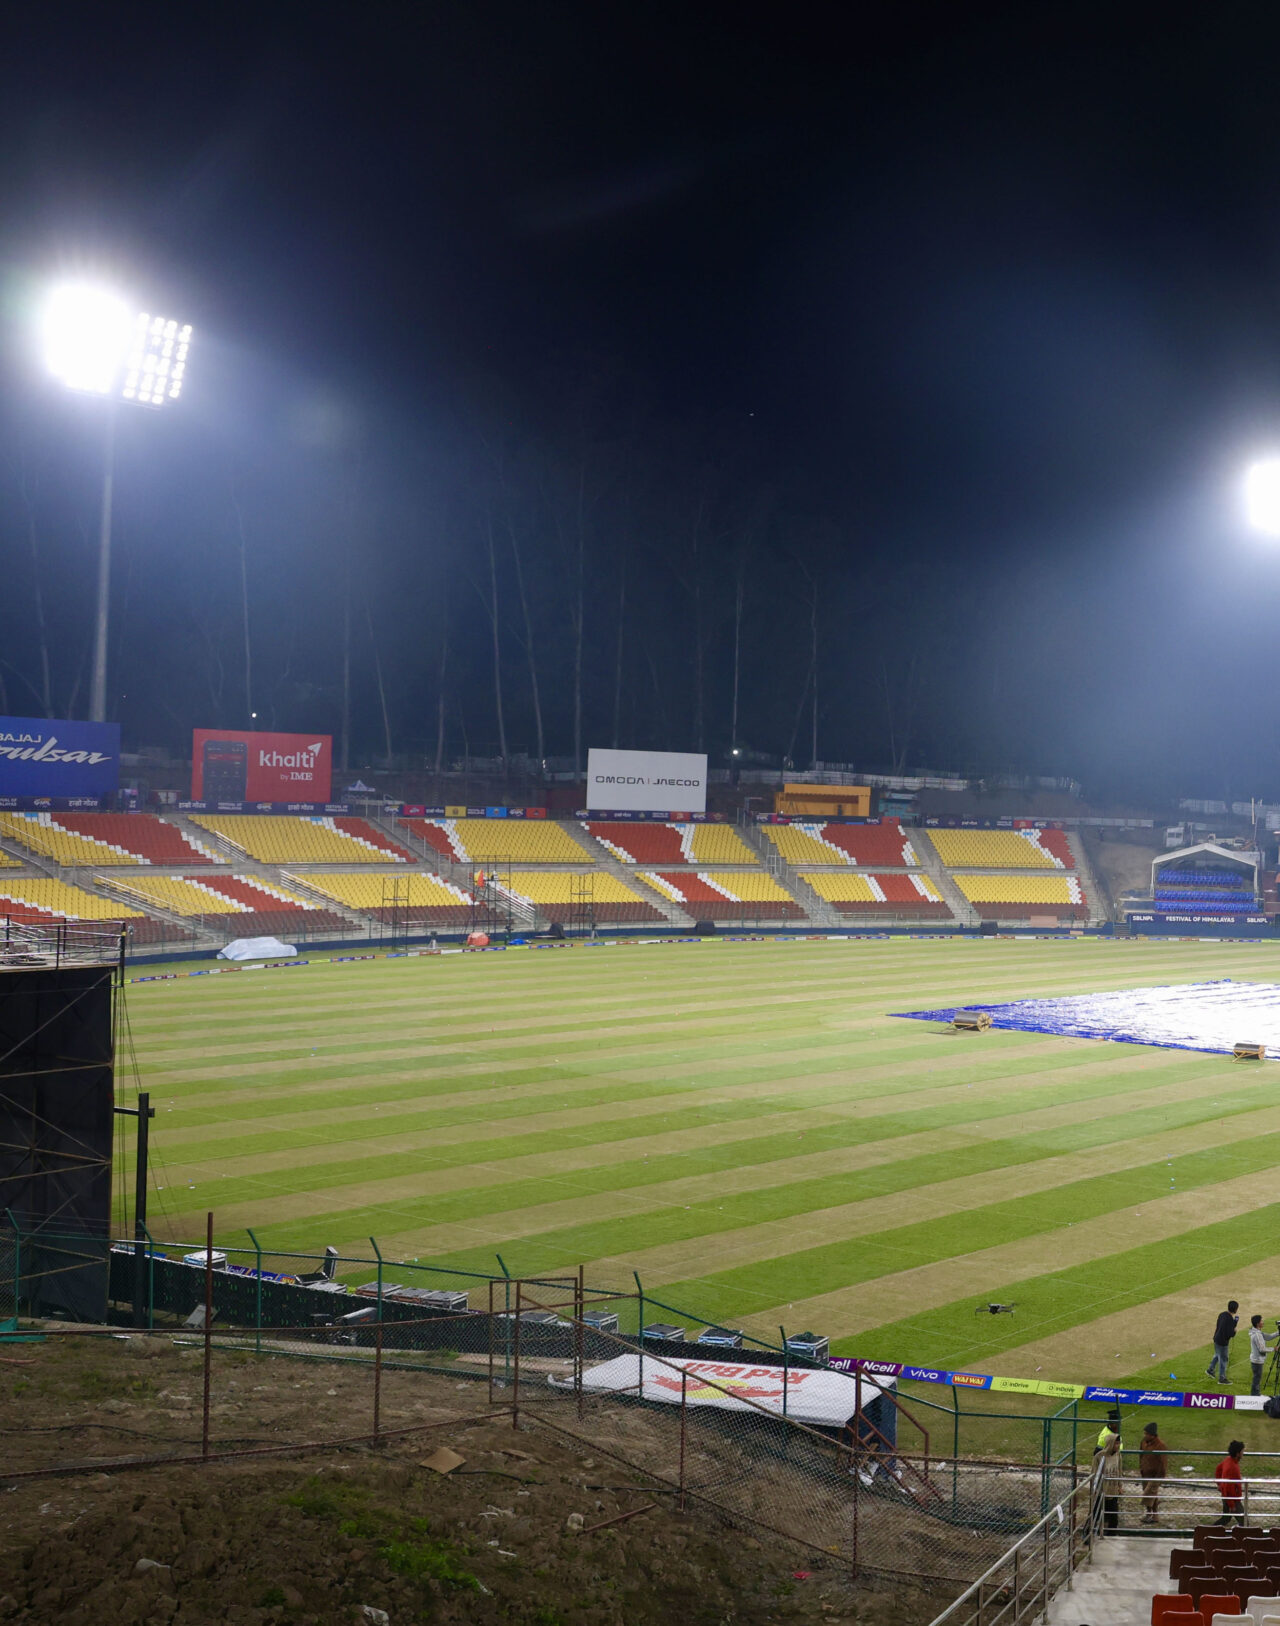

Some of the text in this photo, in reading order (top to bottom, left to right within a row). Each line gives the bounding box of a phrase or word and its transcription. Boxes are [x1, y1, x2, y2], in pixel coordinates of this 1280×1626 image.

[0, 733, 42, 743] AJAJ
[259, 750, 315, 768] khalti
[280, 772, 313, 781] by IME
[595, 775, 700, 787] OMODA JAECOO
[827, 1359, 852, 1370] cell
[861, 1361, 896, 1373] Ncell
[683, 1362, 812, 1385] Red Bull
[910, 1369, 939, 1380] vivo
[1190, 1395, 1227, 1408] Ncell
